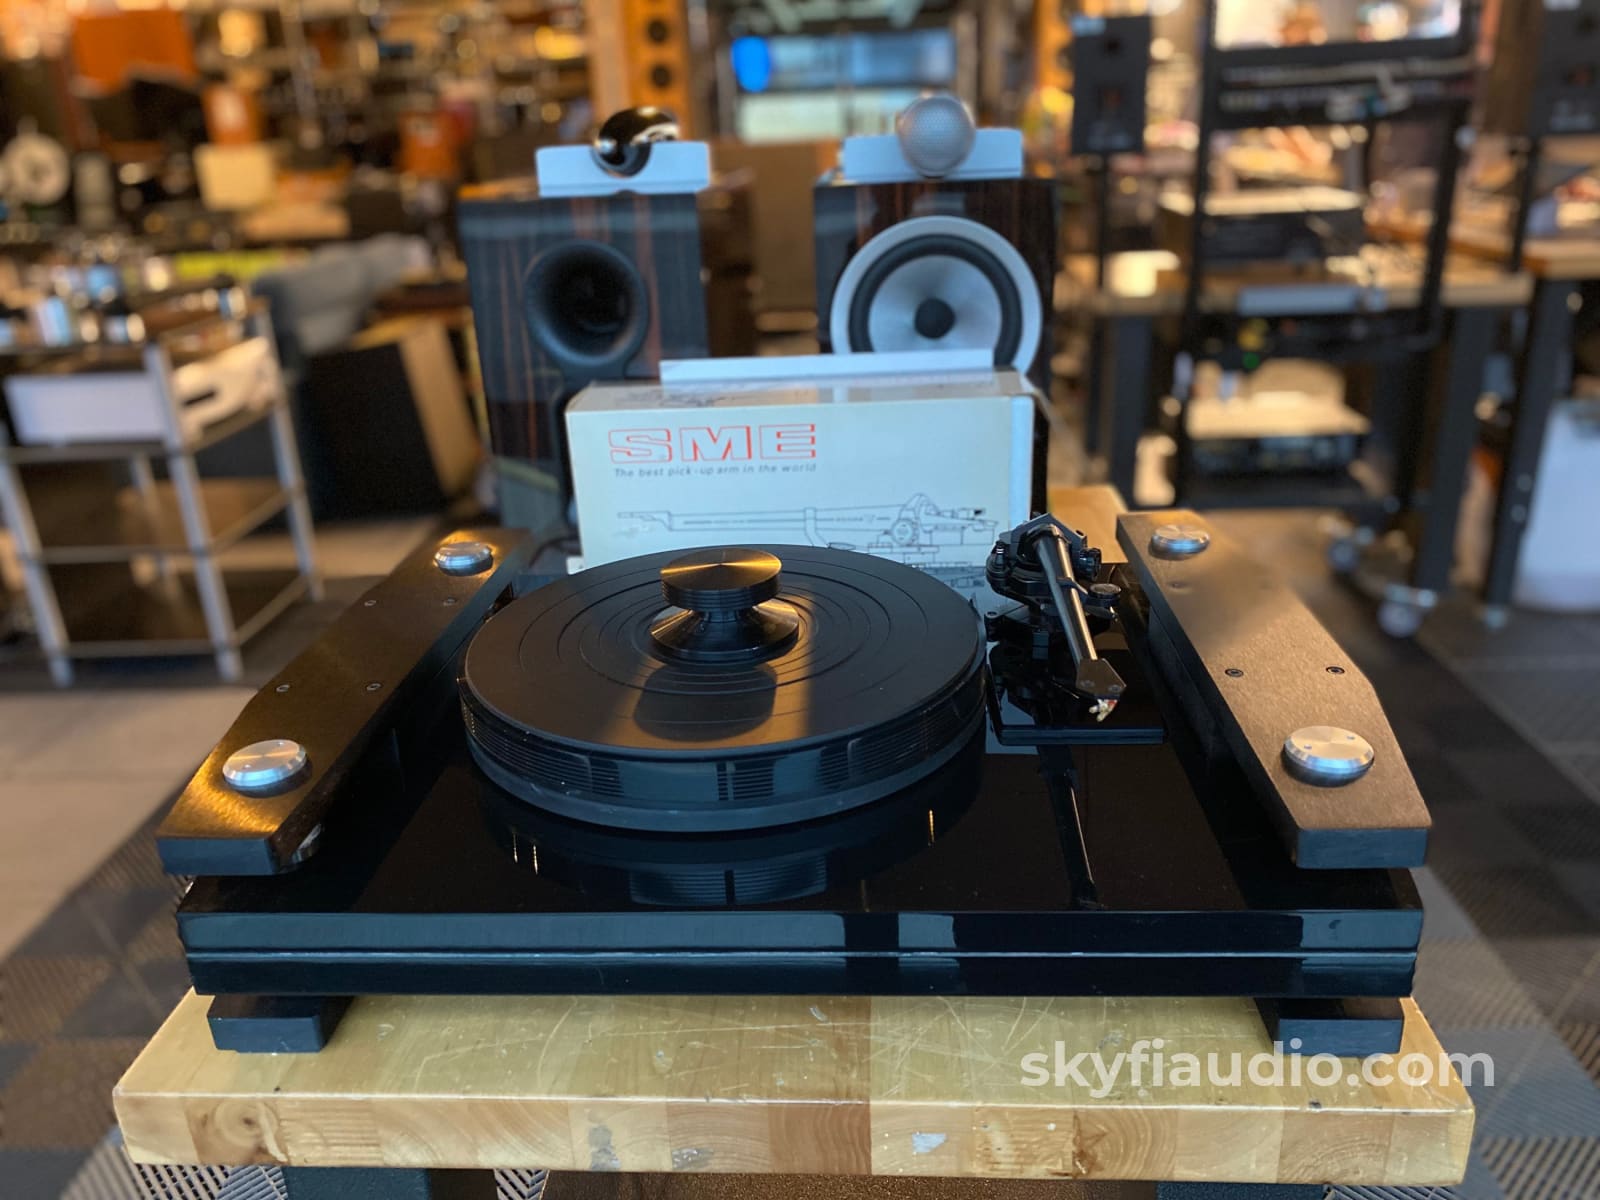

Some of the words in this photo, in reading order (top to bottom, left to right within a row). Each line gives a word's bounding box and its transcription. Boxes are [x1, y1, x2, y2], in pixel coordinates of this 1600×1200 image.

[608, 423, 816, 464] SME
[614, 468, 634, 478] The
[638, 467, 664, 477] best
[716, 466, 740, 475] arm
[742, 463, 754, 473] in
[758, 462, 777, 473] the
[781, 462, 817, 473] world
